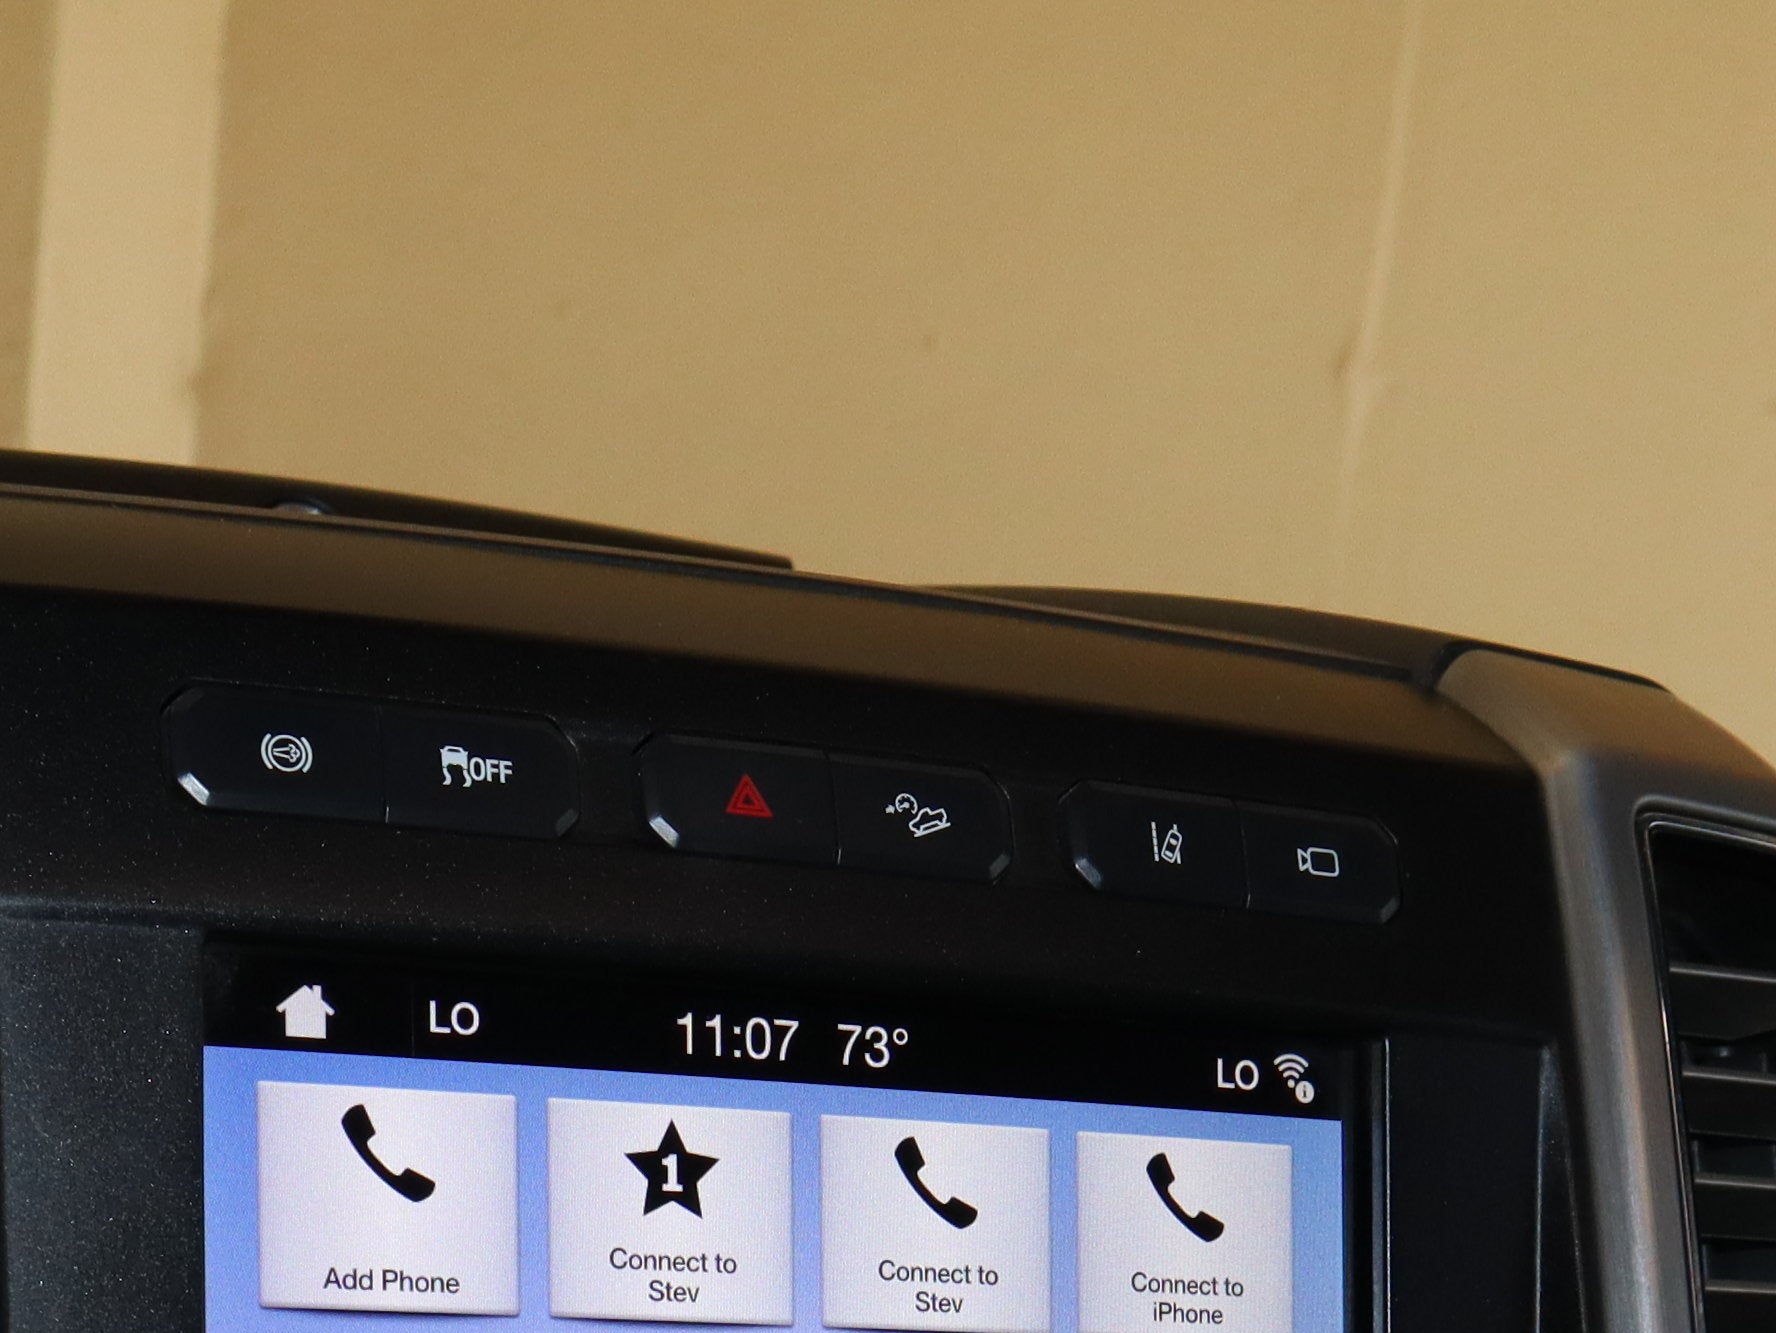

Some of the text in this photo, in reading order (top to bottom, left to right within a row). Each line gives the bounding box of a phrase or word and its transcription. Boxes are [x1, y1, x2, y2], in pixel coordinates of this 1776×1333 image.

[469, 756, 513, 783] OFF
[429, 1000, 480, 1036] LO
[677, 1012, 799, 1061] 11:07
[837, 1023, 909, 1068] 73°
[1217, 1058, 1260, 1091] LO
[609, 1246, 738, 1275] Connect to
[878, 1259, 999, 1286] Connect to
[323, 1266, 460, 1295] Add Phone
[648, 1279, 700, 1303] Stev
[1130, 1271, 1245, 1298] Connect to
[915, 1290, 964, 1314] Stev
[1153, 1301, 1224, 1325] iPhone
